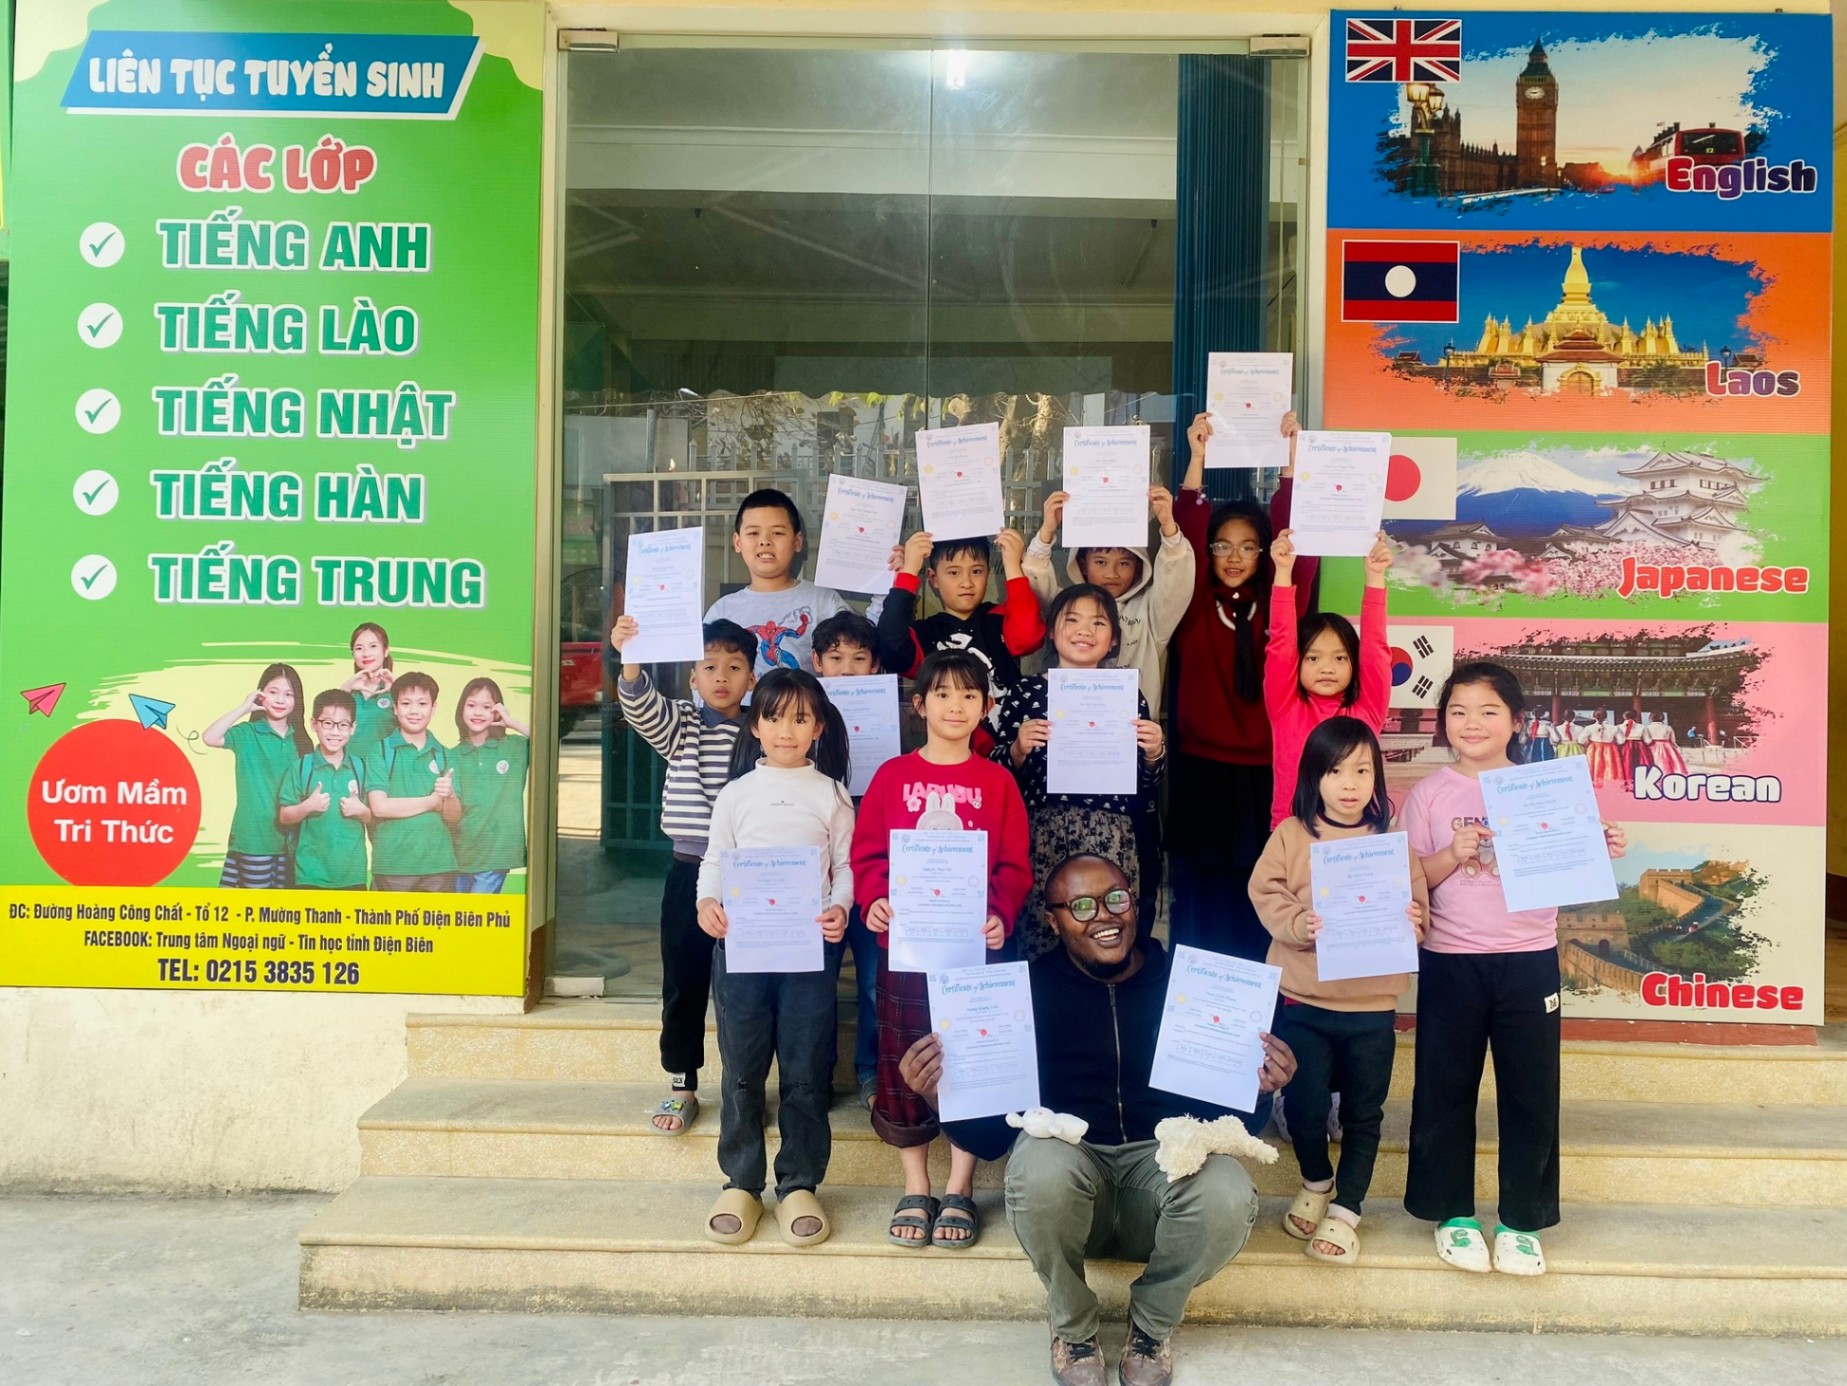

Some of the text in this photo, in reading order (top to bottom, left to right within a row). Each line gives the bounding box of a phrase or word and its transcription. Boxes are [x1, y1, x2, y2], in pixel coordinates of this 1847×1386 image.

[88, 43, 445, 101] LIÊN TỤC TUYỂN SINH
[178, 132, 377, 194] CÁC LỚP
[1665, 155, 1818, 200] English
[157, 206, 431, 272] TIẾNG ANH
[155, 290, 418, 354] TIẾNG LÀO
[1705, 360, 1800, 397] Laos
[153, 373, 455, 448] TIẾNG NHẬT
[151, 457, 426, 523] TIẾNG HÀN
[149, 541, 486, 607] TIẾNG TRUNG
[1617, 556, 1811, 598] Japanese
[41, 777, 187, 806] Ươm Mầm
[1633, 764, 1783, 804] Korean
[54, 818, 174, 844] Tri Thức
[9, 903, 30, 919] ĐC:
[34, 903, 72, 922] Đường
[77, 904, 115, 922] Hoàng
[120, 904, 150, 922] Công
[155, 902, 182, 921] Chất
[195, 902, 210, 921] Tổ
[214, 906, 229, 922] 12
[245, 906, 255, 922] P.
[259, 906, 301, 925] Mường
[305, 908, 342, 924] Thanh
[355, 908, 391, 926] Thành
[396, 907, 420, 926] Phố
[423, 910, 451, 930] Điện
[455, 911, 483, 927] Biên
[487, 910, 511, 928] Phủ
[84, 931, 152, 947] FACEBOOK:
[156, 932, 191, 949] Trung
[194, 933, 218, 948] tâm
[222, 933, 259, 952] Ngoại
[263, 933, 285, 952] ngữ
[298, 934, 316, 951] Tin
[320, 934, 343, 954] học
[346, 933, 370, 952] tỉnh
[373, 936, 402, 955] Điện
[405, 936, 434, 953] Biên
[158, 958, 360, 985] TEL: 0215 3835 126
[1641, 972, 1804, 1011] Chinese
